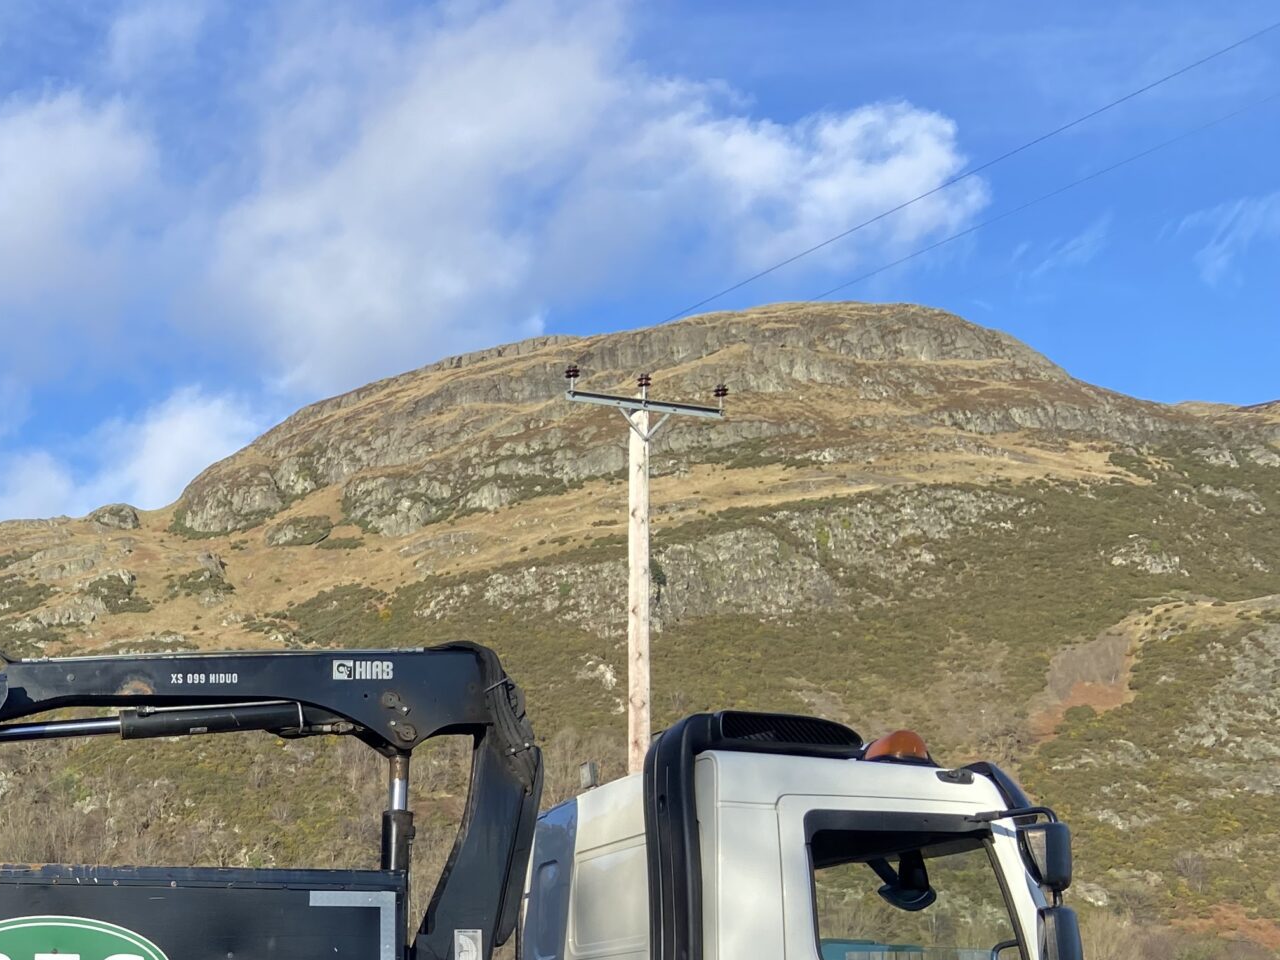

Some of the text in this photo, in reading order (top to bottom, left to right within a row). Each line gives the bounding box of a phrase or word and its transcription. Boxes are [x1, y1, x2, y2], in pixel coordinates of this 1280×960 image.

[171, 672, 238, 684] XS 099 HIDUO
[355, 660, 394, 680] HIAB
